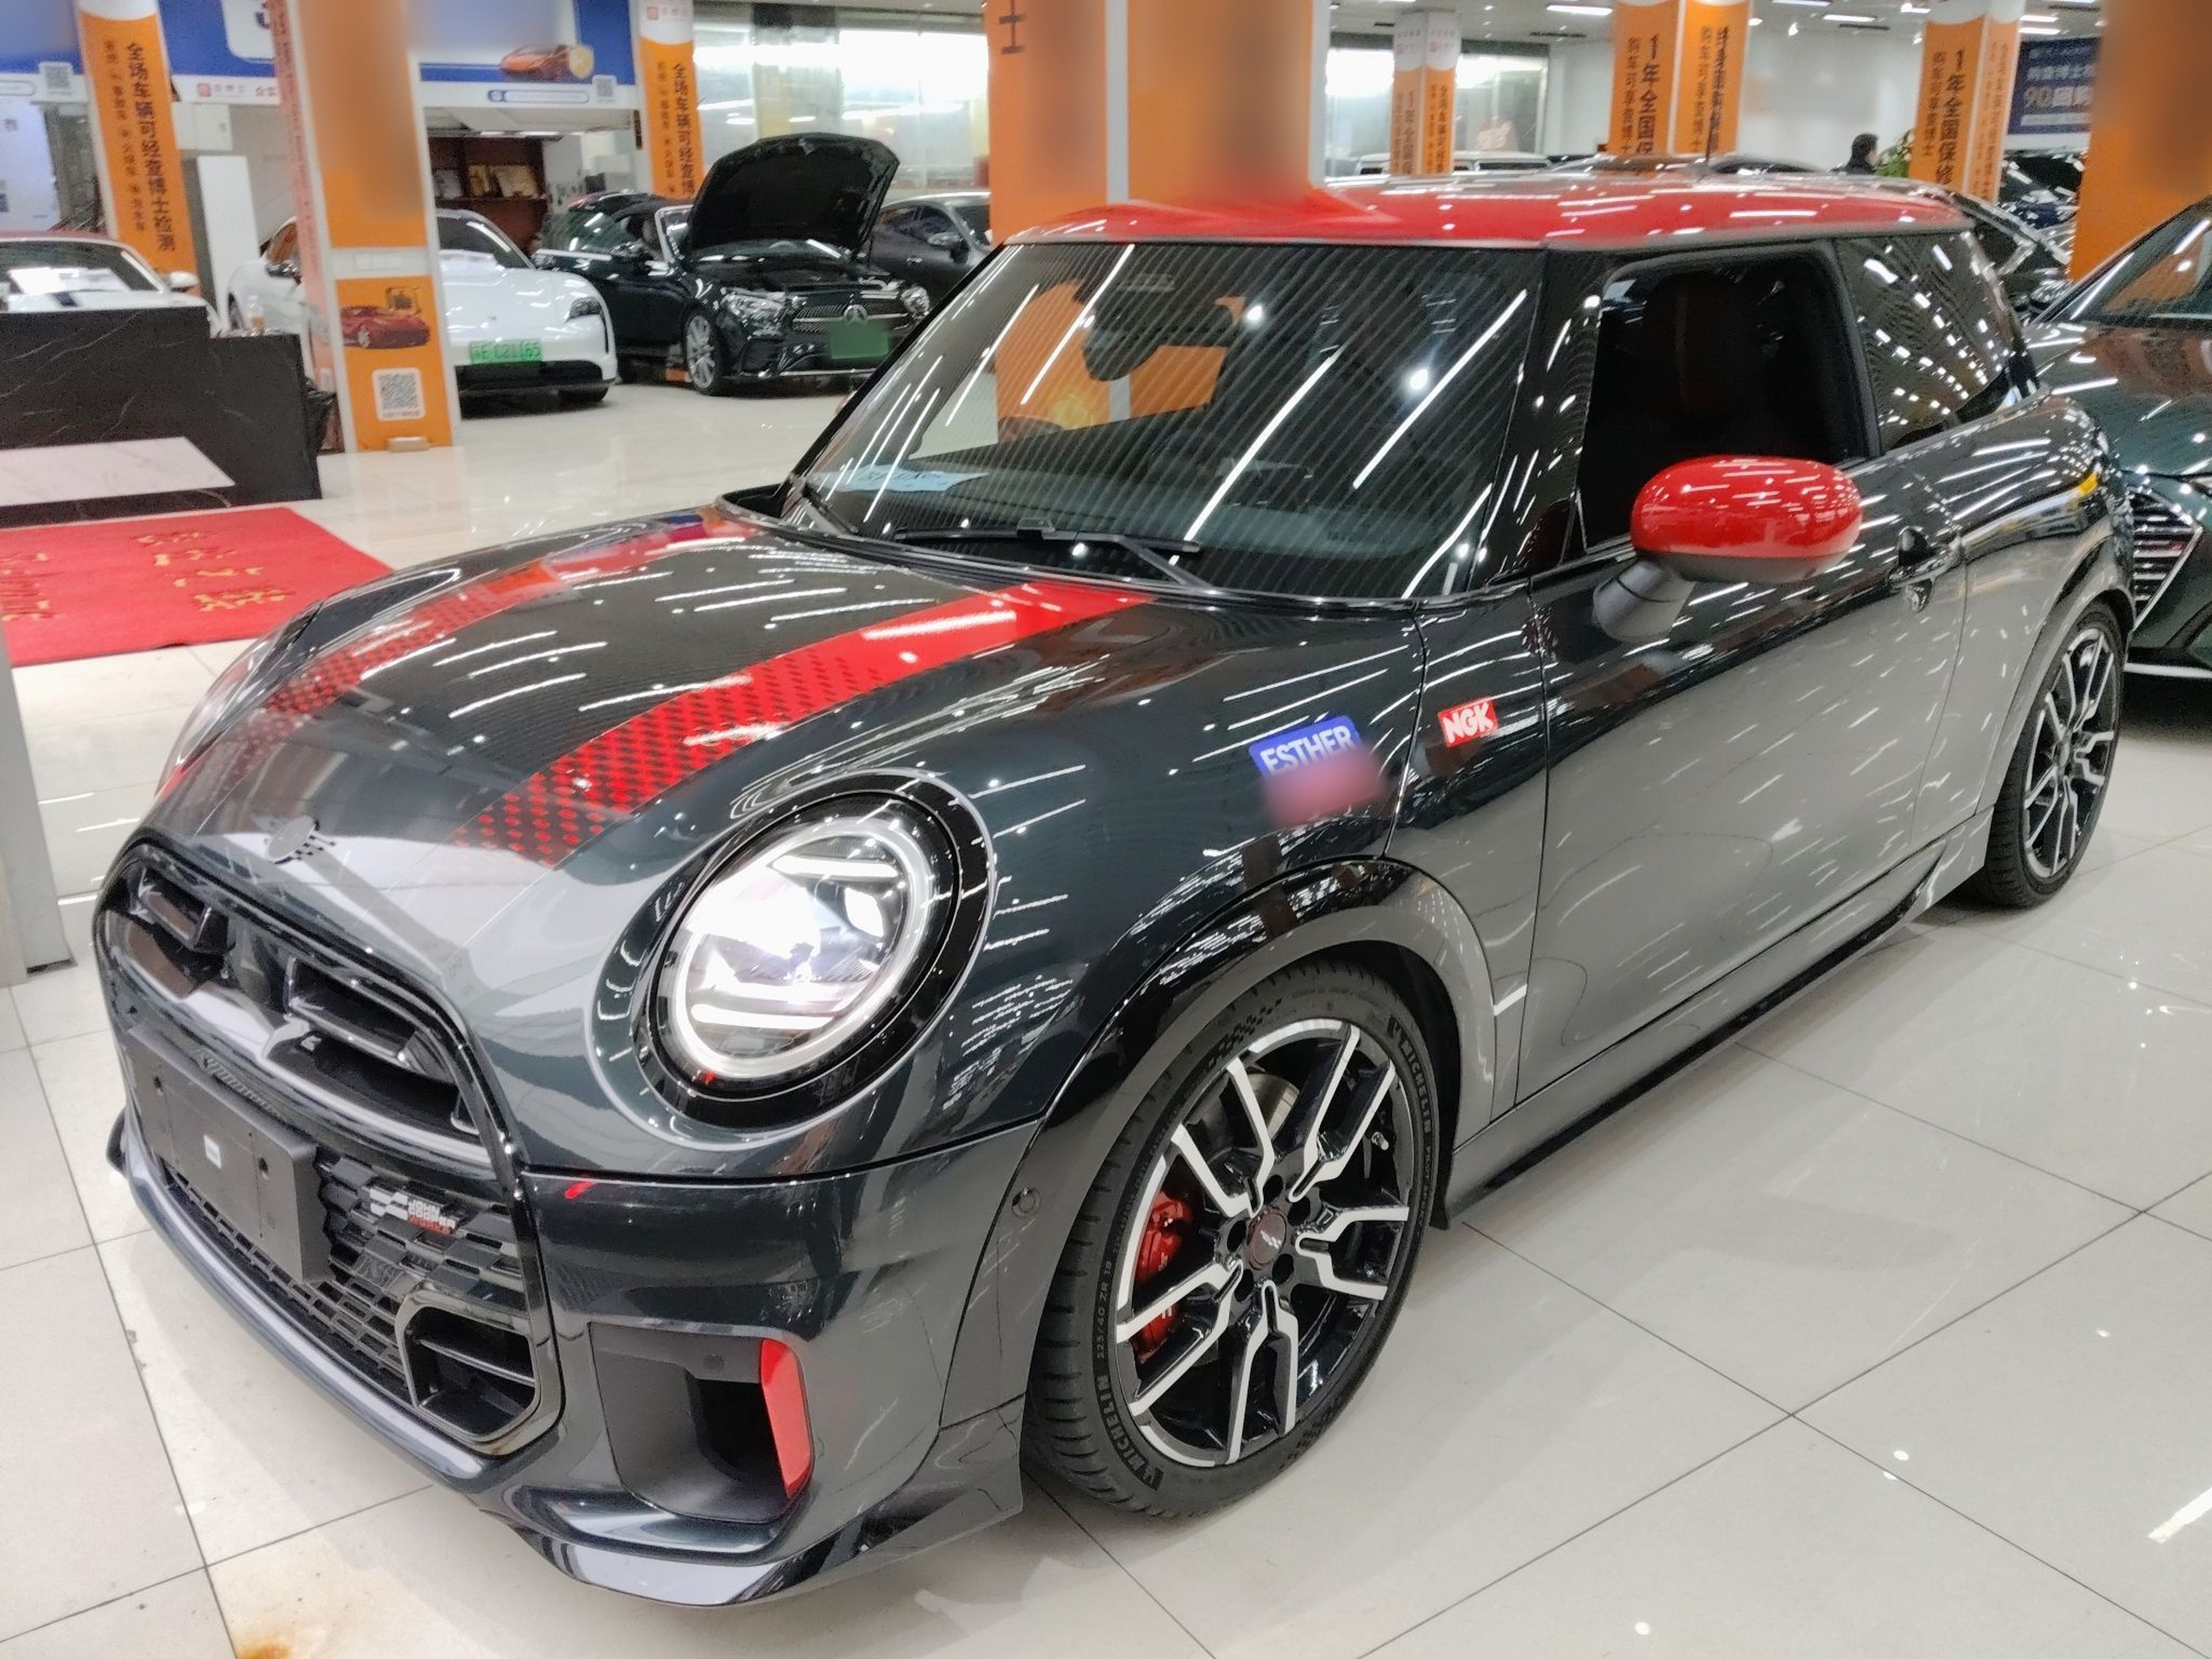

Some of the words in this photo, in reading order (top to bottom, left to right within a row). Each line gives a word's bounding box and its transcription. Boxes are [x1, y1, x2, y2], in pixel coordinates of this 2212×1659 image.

[1442, 702, 1494, 744] NGK
[1260, 725, 1358, 777] ESTHER
[1399, 1036, 1432, 1137] MICHELIN
[1097, 1279, 1110, 1305] ZR
[1102, 1258, 1113, 1277] 18
[1095, 1303, 1107, 1364] 225/40
[1096, 1368, 1146, 1476] MICHELIN
